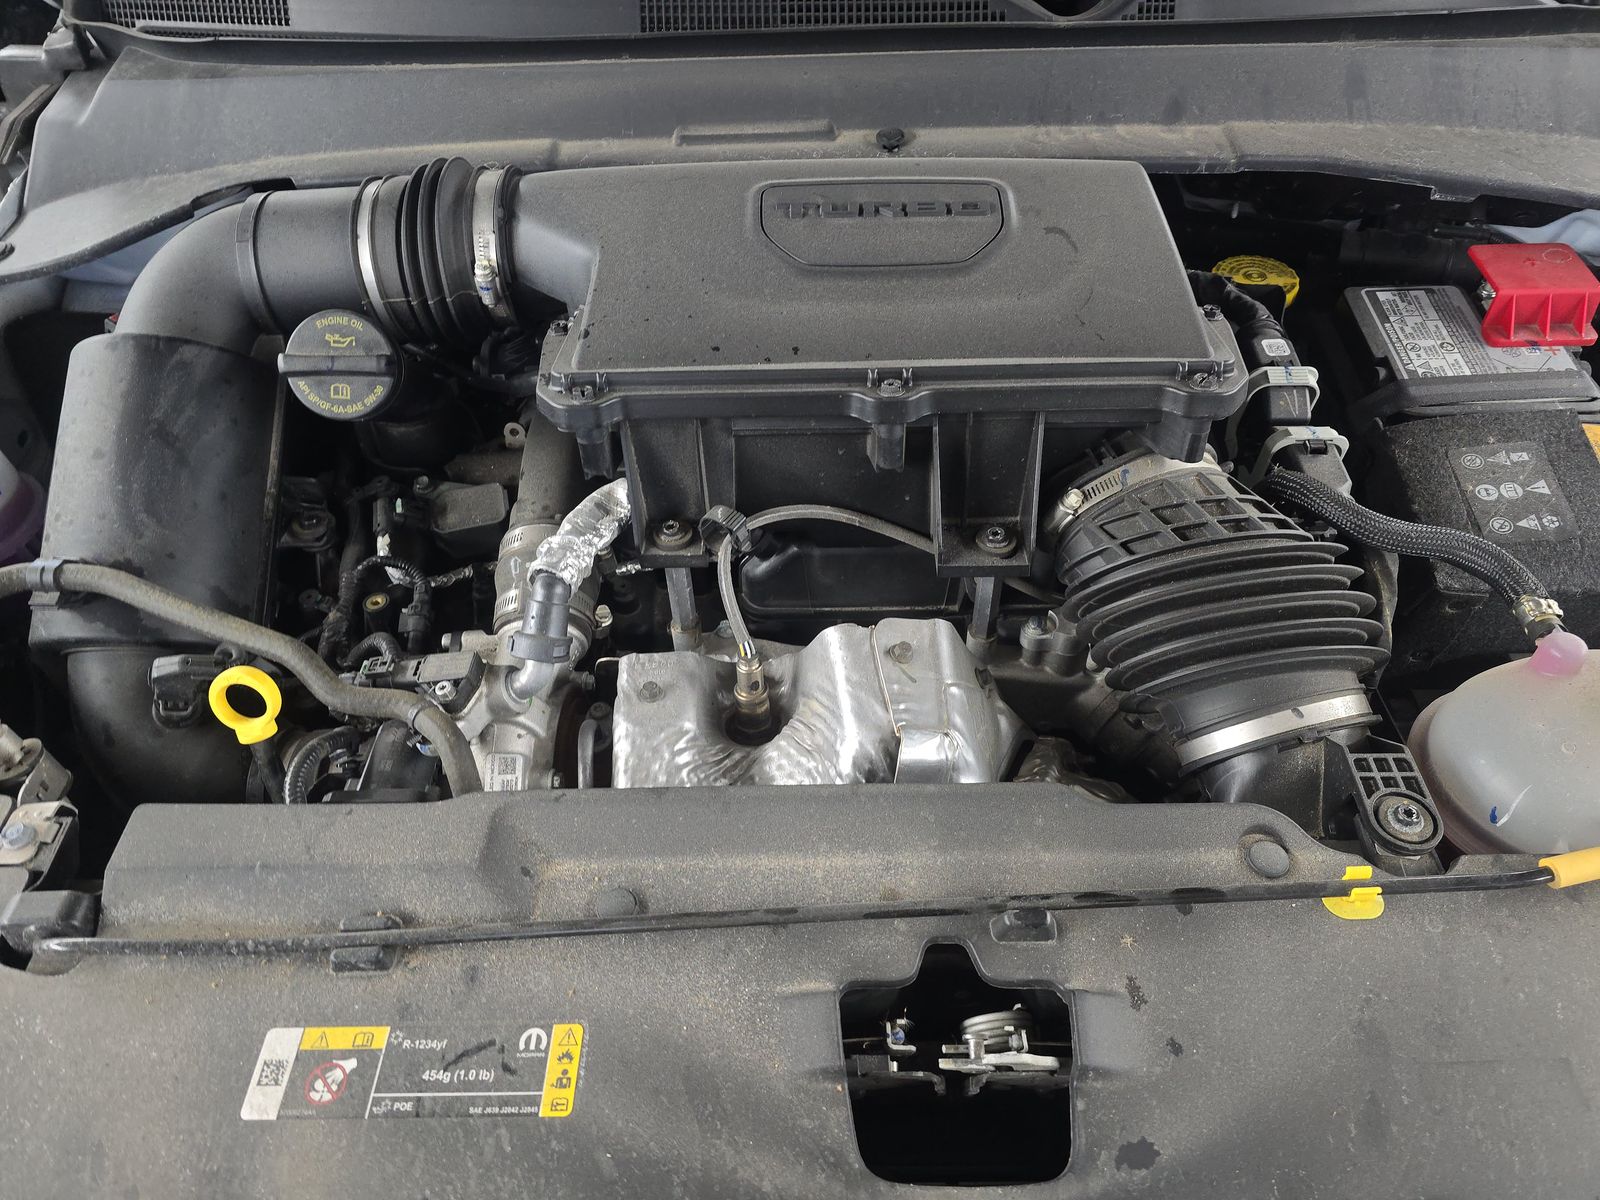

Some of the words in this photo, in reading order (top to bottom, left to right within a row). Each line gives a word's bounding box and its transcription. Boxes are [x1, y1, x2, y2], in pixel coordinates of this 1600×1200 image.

[776, 202, 997, 219] TURBO
[316, 316, 349, 329] ENGINE
[350, 319, 364, 331] OIL
[298, 381, 311, 395] API
[402, 1039, 448, 1051] R-1234yf
[422, 1069, 451, 1083] 454g
[454, 1069, 476, 1083] (1.0
[479, 1069, 495, 1082] lb)
[393, 1101, 414, 1111] POE
[468, 1106, 483, 1114] SAE
